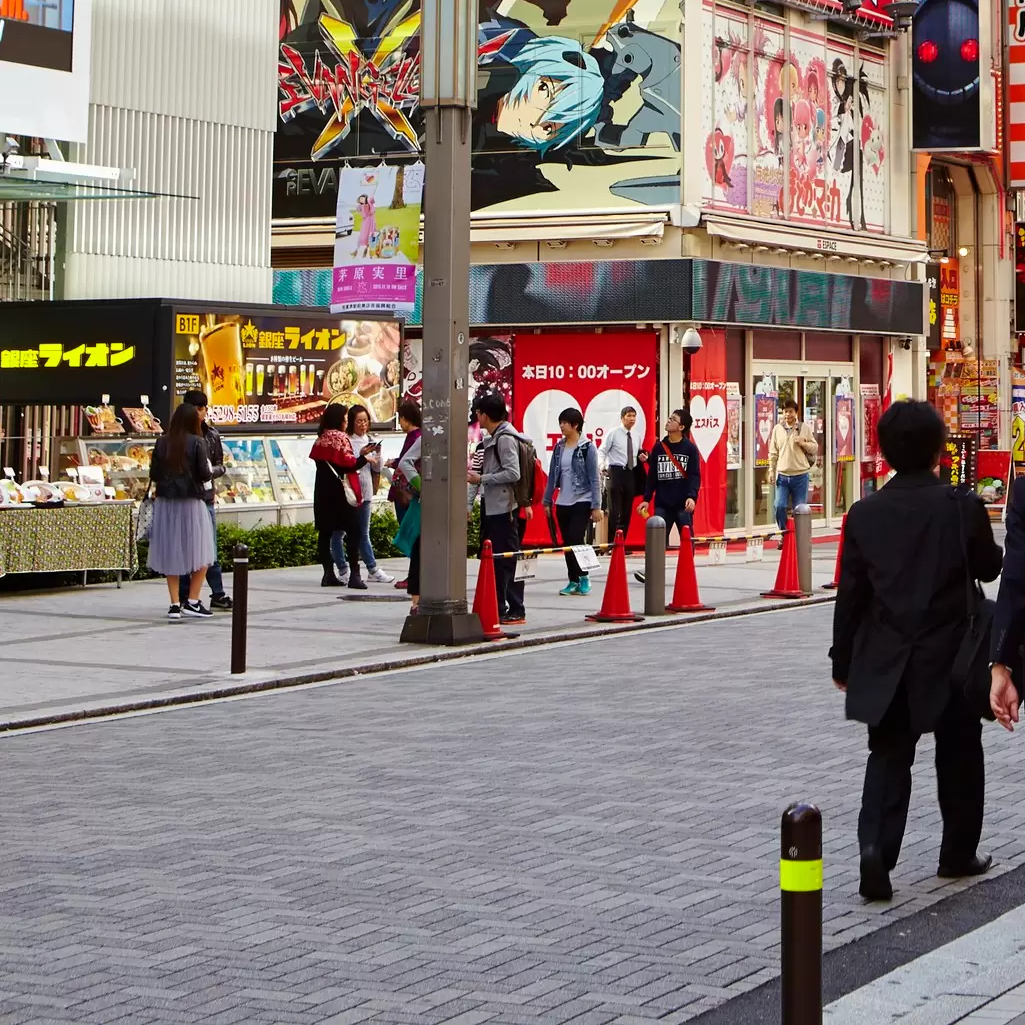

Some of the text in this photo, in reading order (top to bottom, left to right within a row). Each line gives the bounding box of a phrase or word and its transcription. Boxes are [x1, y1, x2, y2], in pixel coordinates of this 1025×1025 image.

[178, 316, 198, 334] B1F
[258, 326, 347, 351] 銀座ライオン
[0, 342, 136, 369] 銀座ライオン
[694, 415, 720, 430] エスパス
